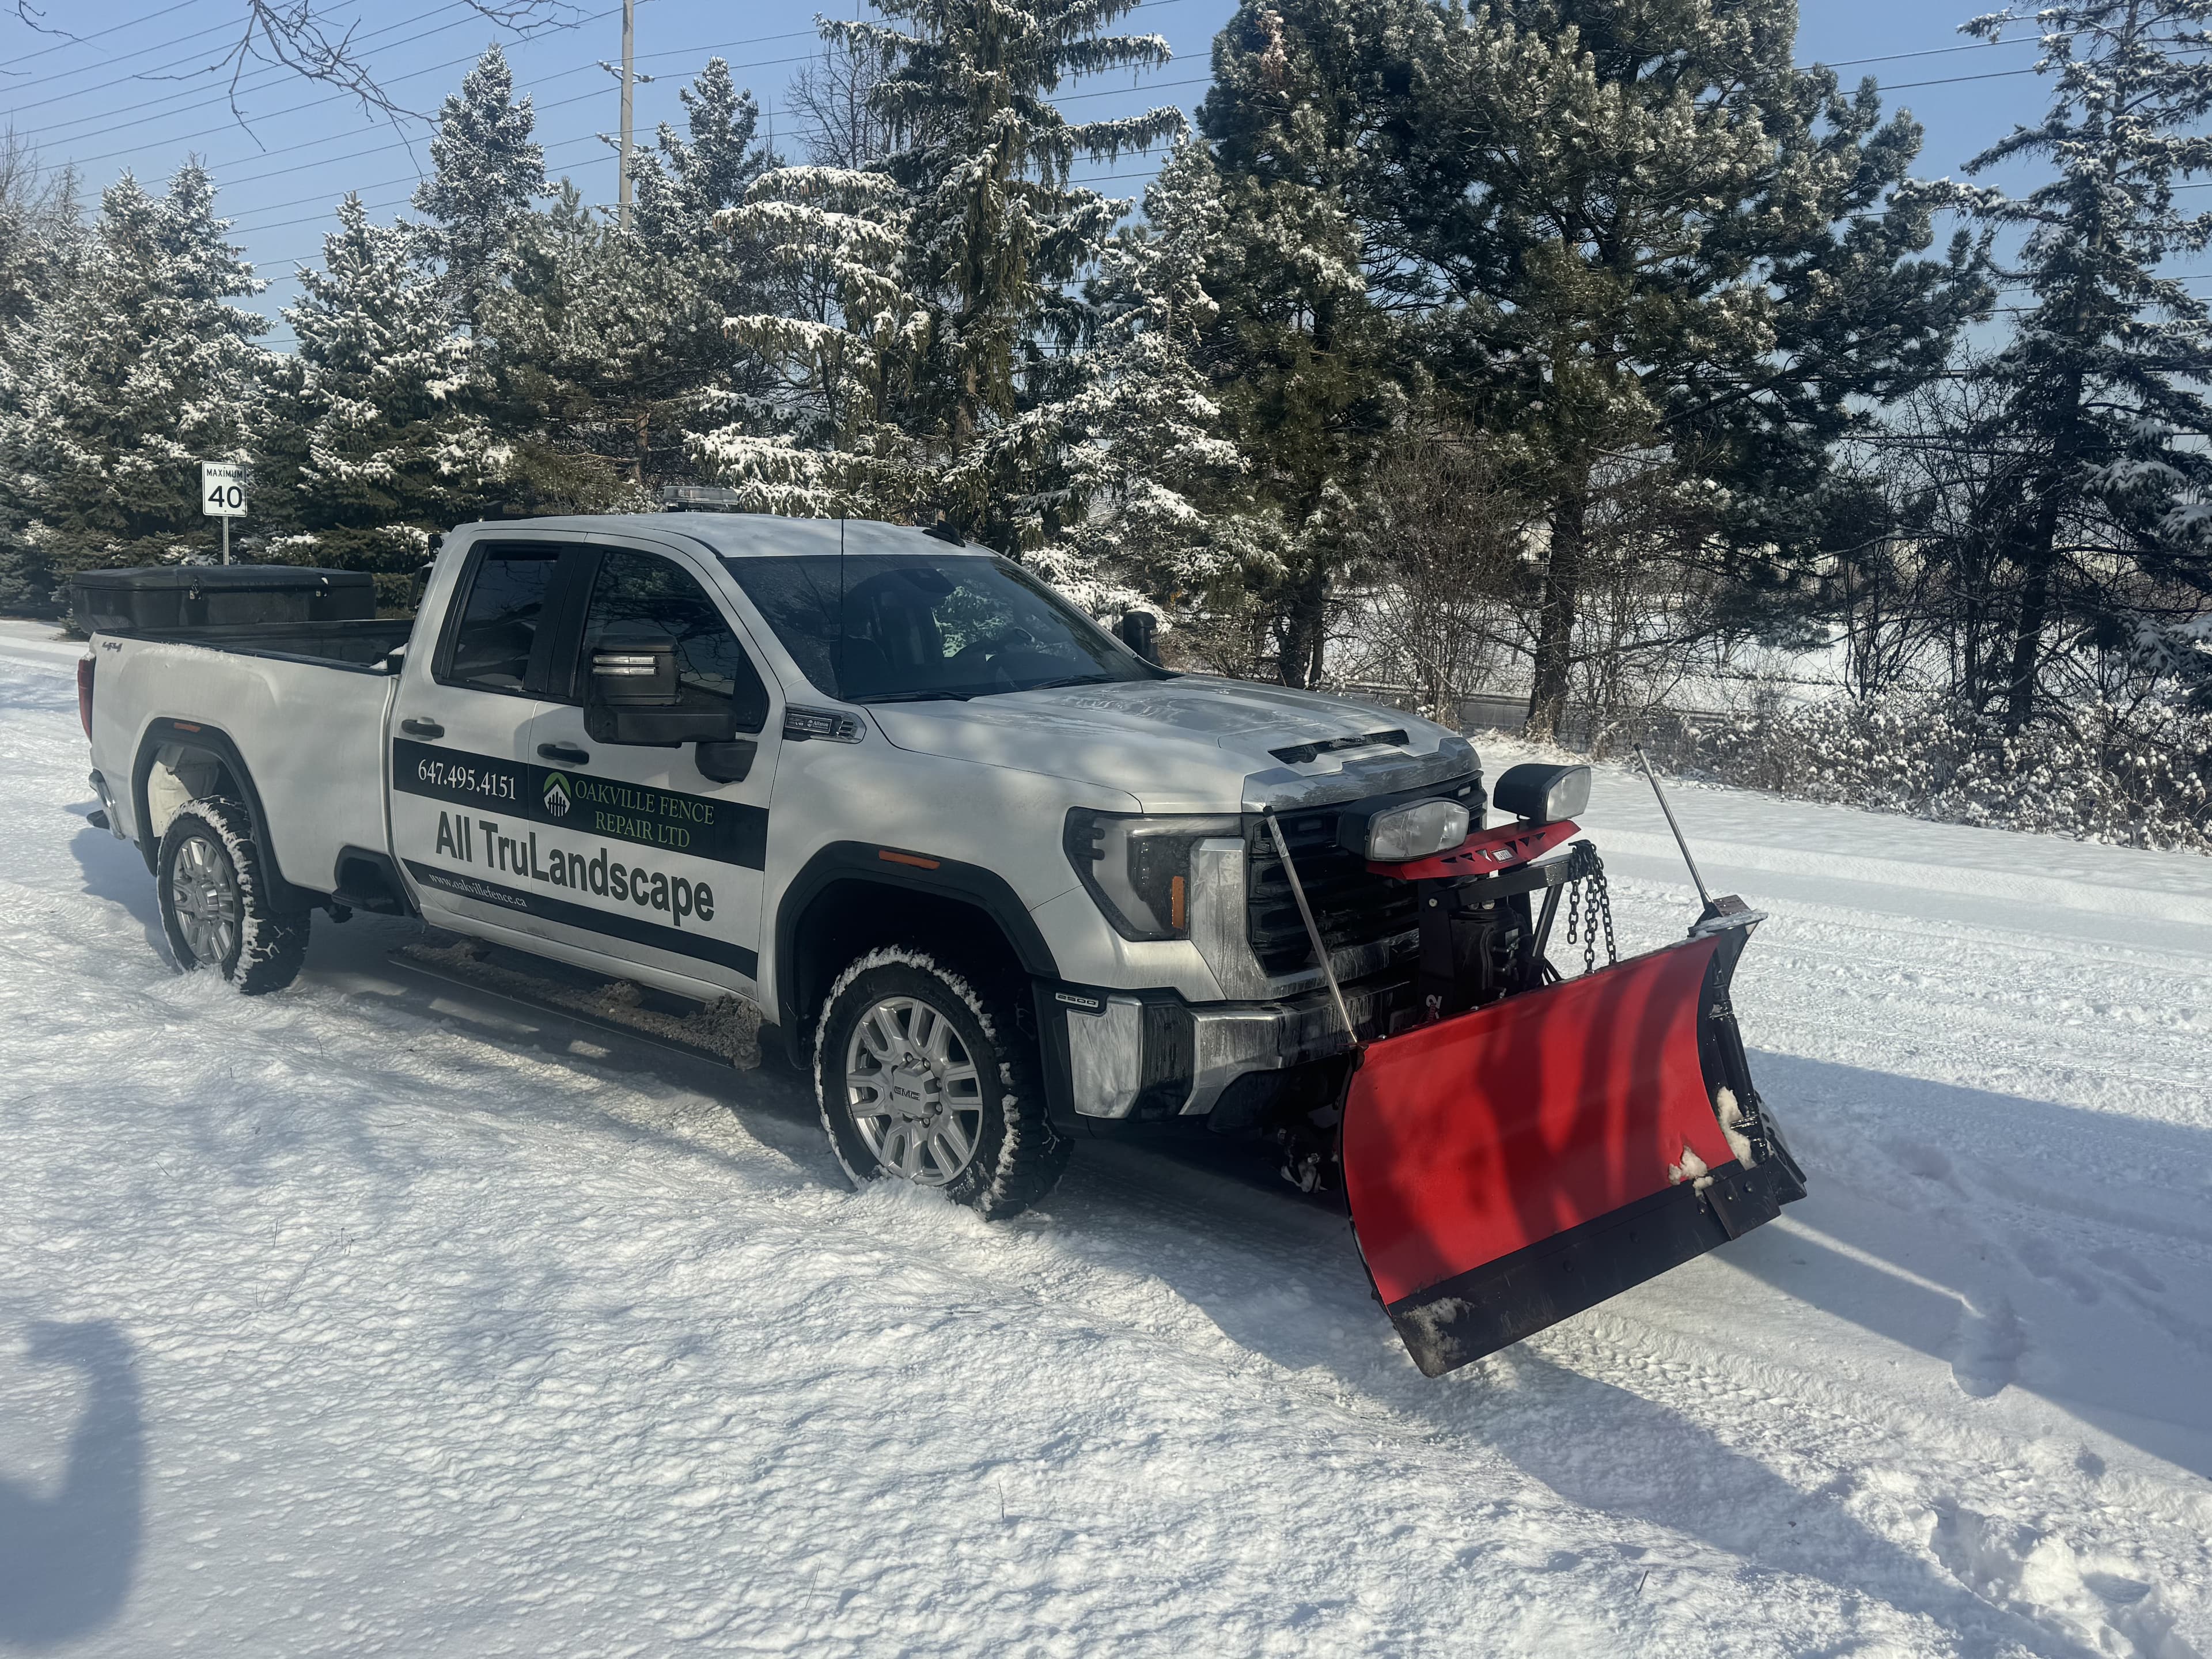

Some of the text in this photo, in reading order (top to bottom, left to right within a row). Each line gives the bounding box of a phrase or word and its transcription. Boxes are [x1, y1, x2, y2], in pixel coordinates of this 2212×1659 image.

[206, 468, 243, 479] MAXIMUM
[208, 486, 243, 509] 40
[418, 759, 516, 800] 647.495.4151
[575, 780, 714, 825] OAKVILLE FENCE
[595, 810, 690, 848] REPAIR LTD
[435, 810, 714, 927] All TruLandscape
[429, 874, 528, 907] www.oakvillefence.ca
[1058, 994, 1096, 1005] 2500
[894, 1085, 921, 1101] GMC
